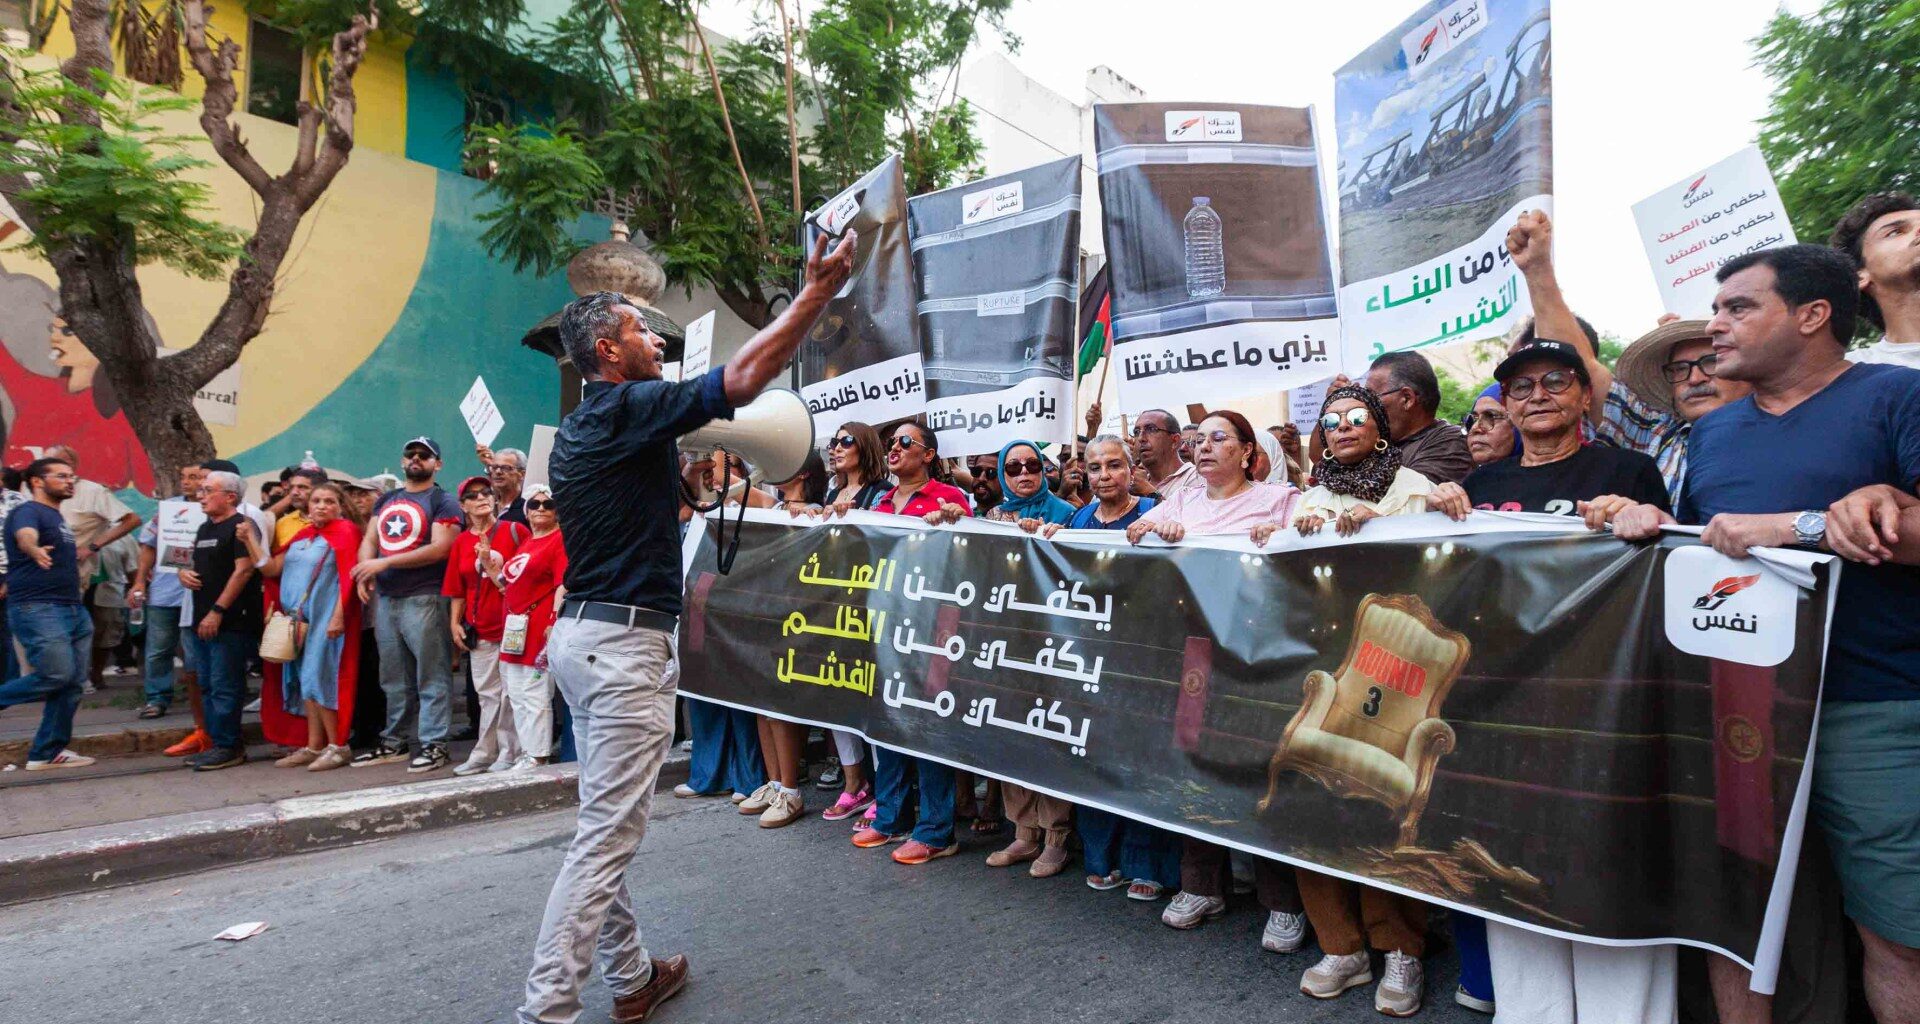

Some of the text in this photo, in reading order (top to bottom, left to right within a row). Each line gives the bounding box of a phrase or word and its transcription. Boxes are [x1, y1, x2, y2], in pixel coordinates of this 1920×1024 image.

[1658, 189, 1767, 243] يكفي من العبث
[1684, 187, 1714, 209] نفس
[1665, 211, 1775, 265] يكفي من الفشل
[1366, 263, 1452, 312] البناء
[1459, 251, 1494, 284] من
[1672, 261, 1715, 287] الظلم
[983, 295, 1021, 308] RUPTURE
[1125, 334, 1328, 381] يزي ما عطشتنا
[808, 368, 921, 415] يزي ما ظلمته
[928, 391, 1056, 433] يزي ما مرضتنا
[798, 552, 1113, 631] يكفي من العبث
[1692, 612, 1757, 634] نفس
[782, 605, 1103, 693] يكفي من الظلم
[1353, 639, 1427, 698] ROUND
[777, 648, 1091, 757] يكفي من الفشل
[1362, 685, 1383, 718] 3
